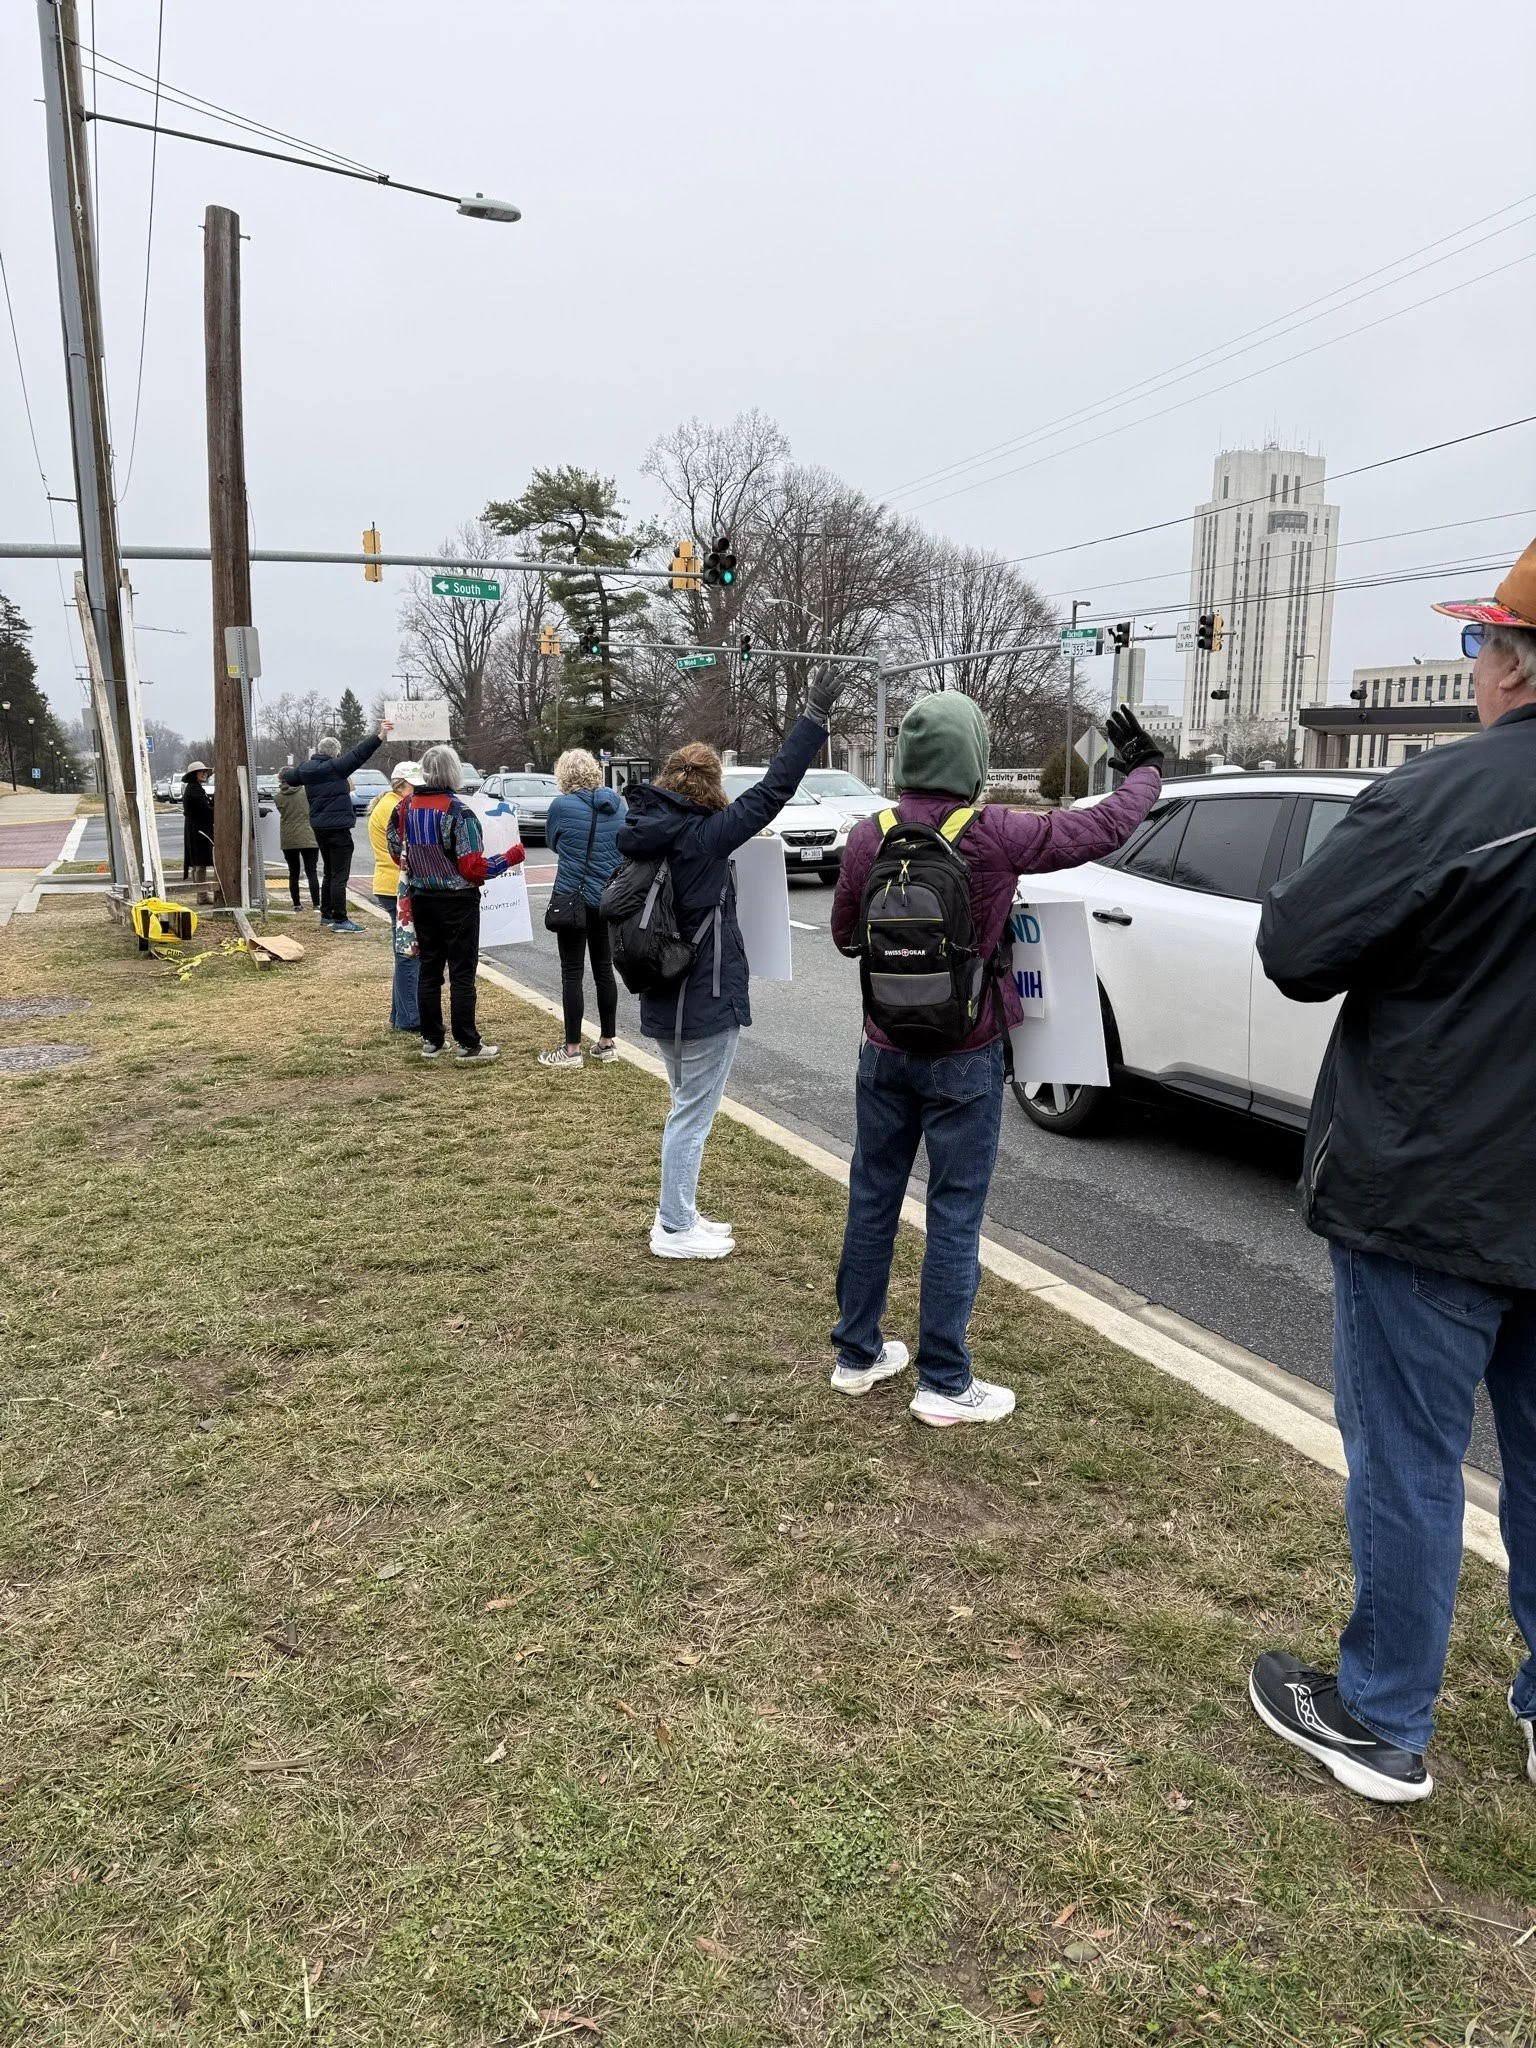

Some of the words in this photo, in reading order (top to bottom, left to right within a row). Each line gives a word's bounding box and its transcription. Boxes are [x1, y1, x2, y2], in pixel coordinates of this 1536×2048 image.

[453, 582, 481, 595] South
[1072, 645, 1084, 656] 355
[396, 703, 419, 713] RFK
[394, 713, 415, 721] Must
[987, 773, 1015, 782] Activity
